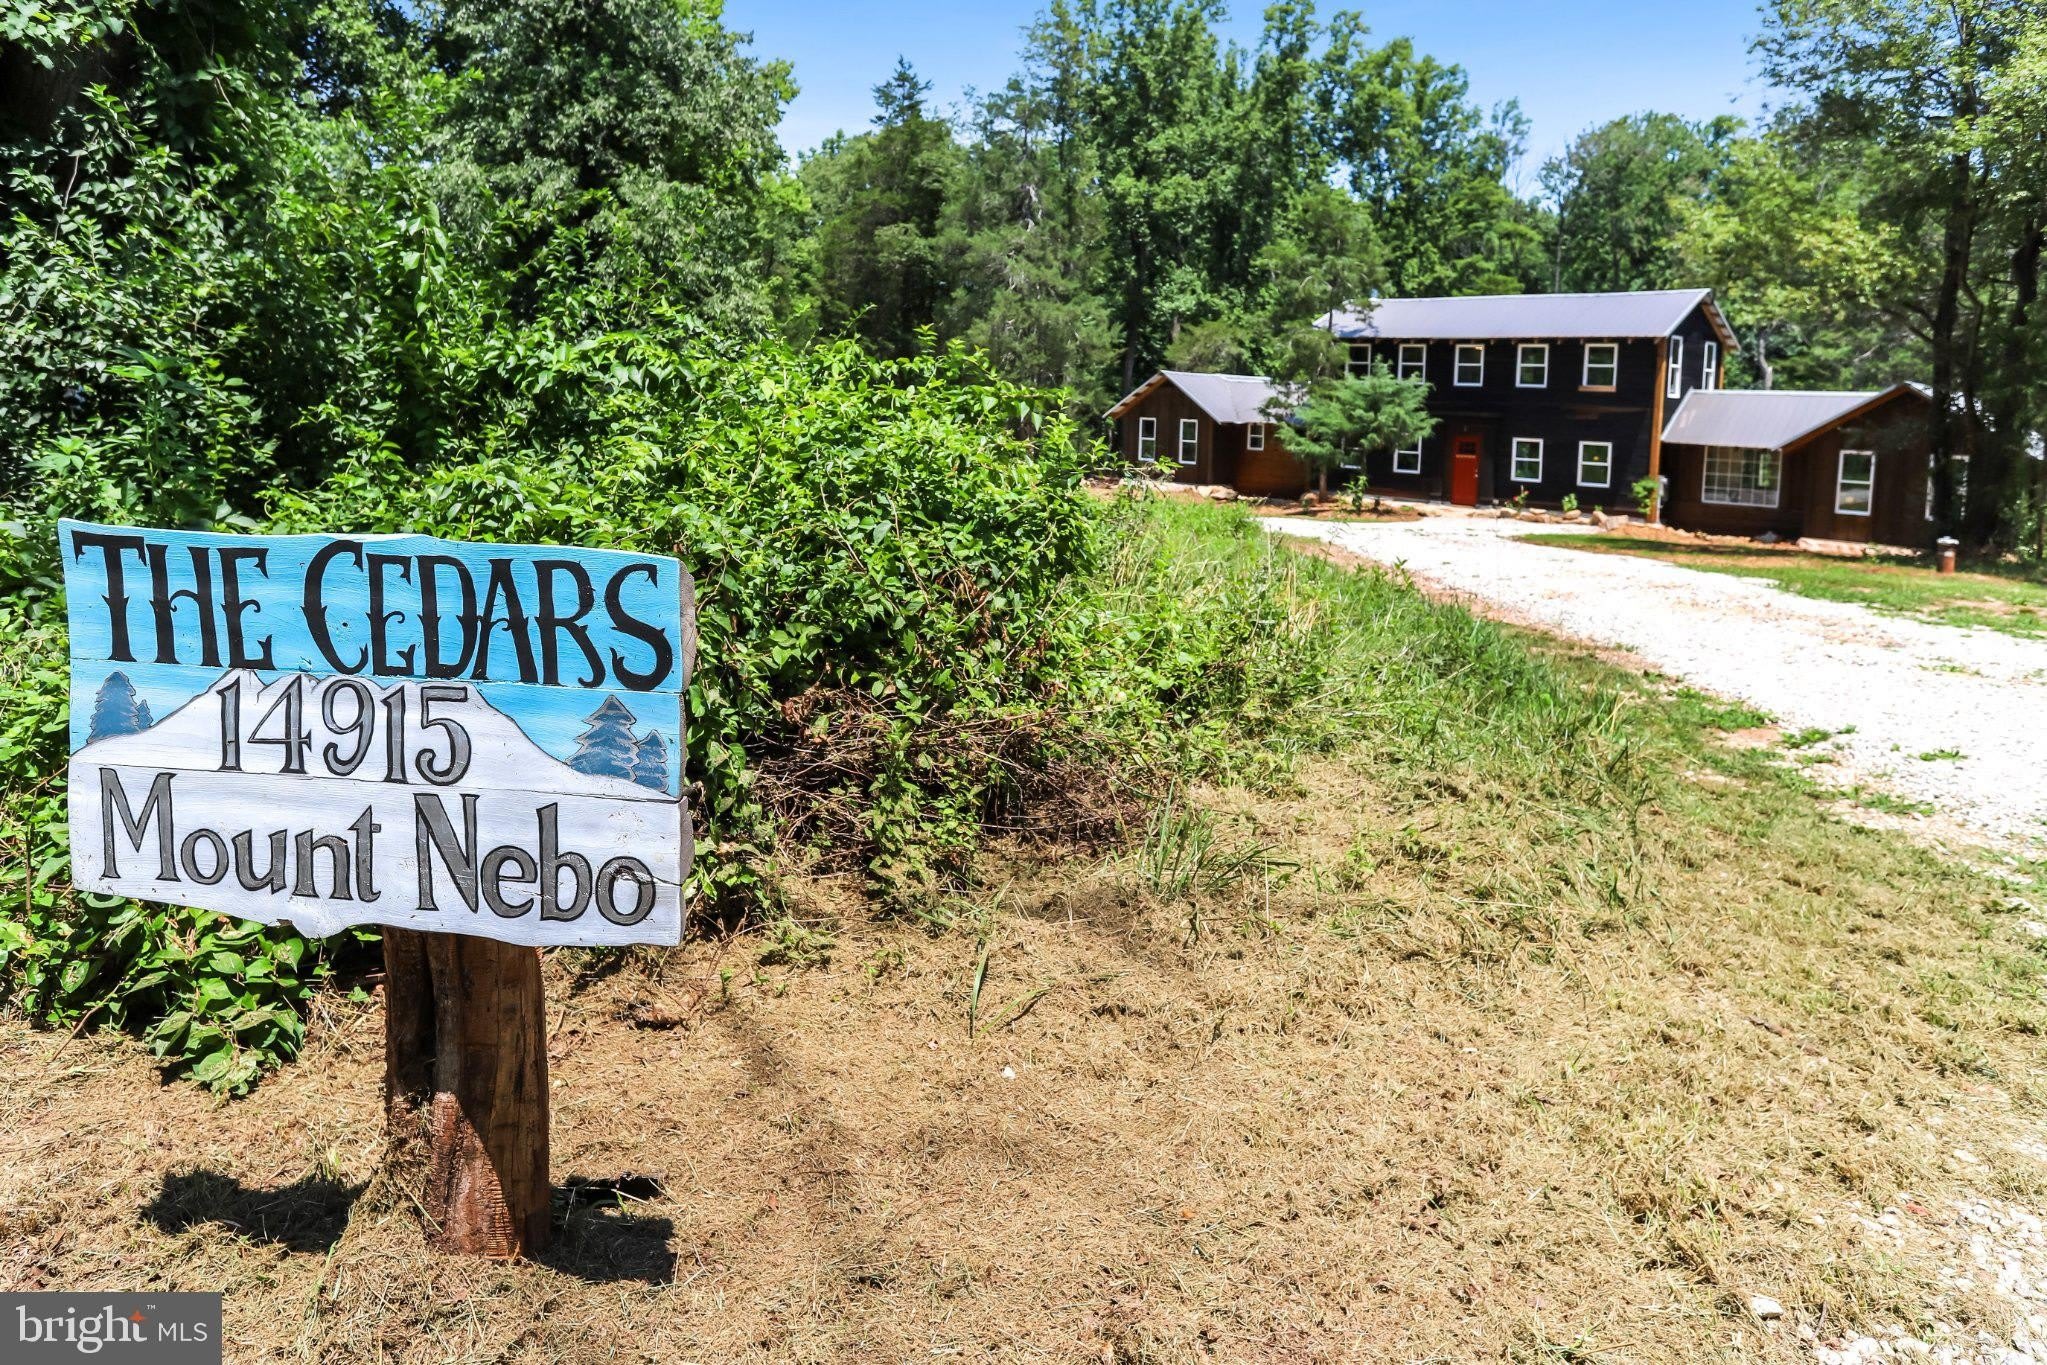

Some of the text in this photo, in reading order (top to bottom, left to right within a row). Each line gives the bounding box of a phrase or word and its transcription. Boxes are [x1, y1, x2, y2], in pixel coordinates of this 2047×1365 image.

[72, 530, 674, 691] THE CEDARS
[216, 674, 472, 786] 14915
[99, 767, 657, 926] Mount Nebo
